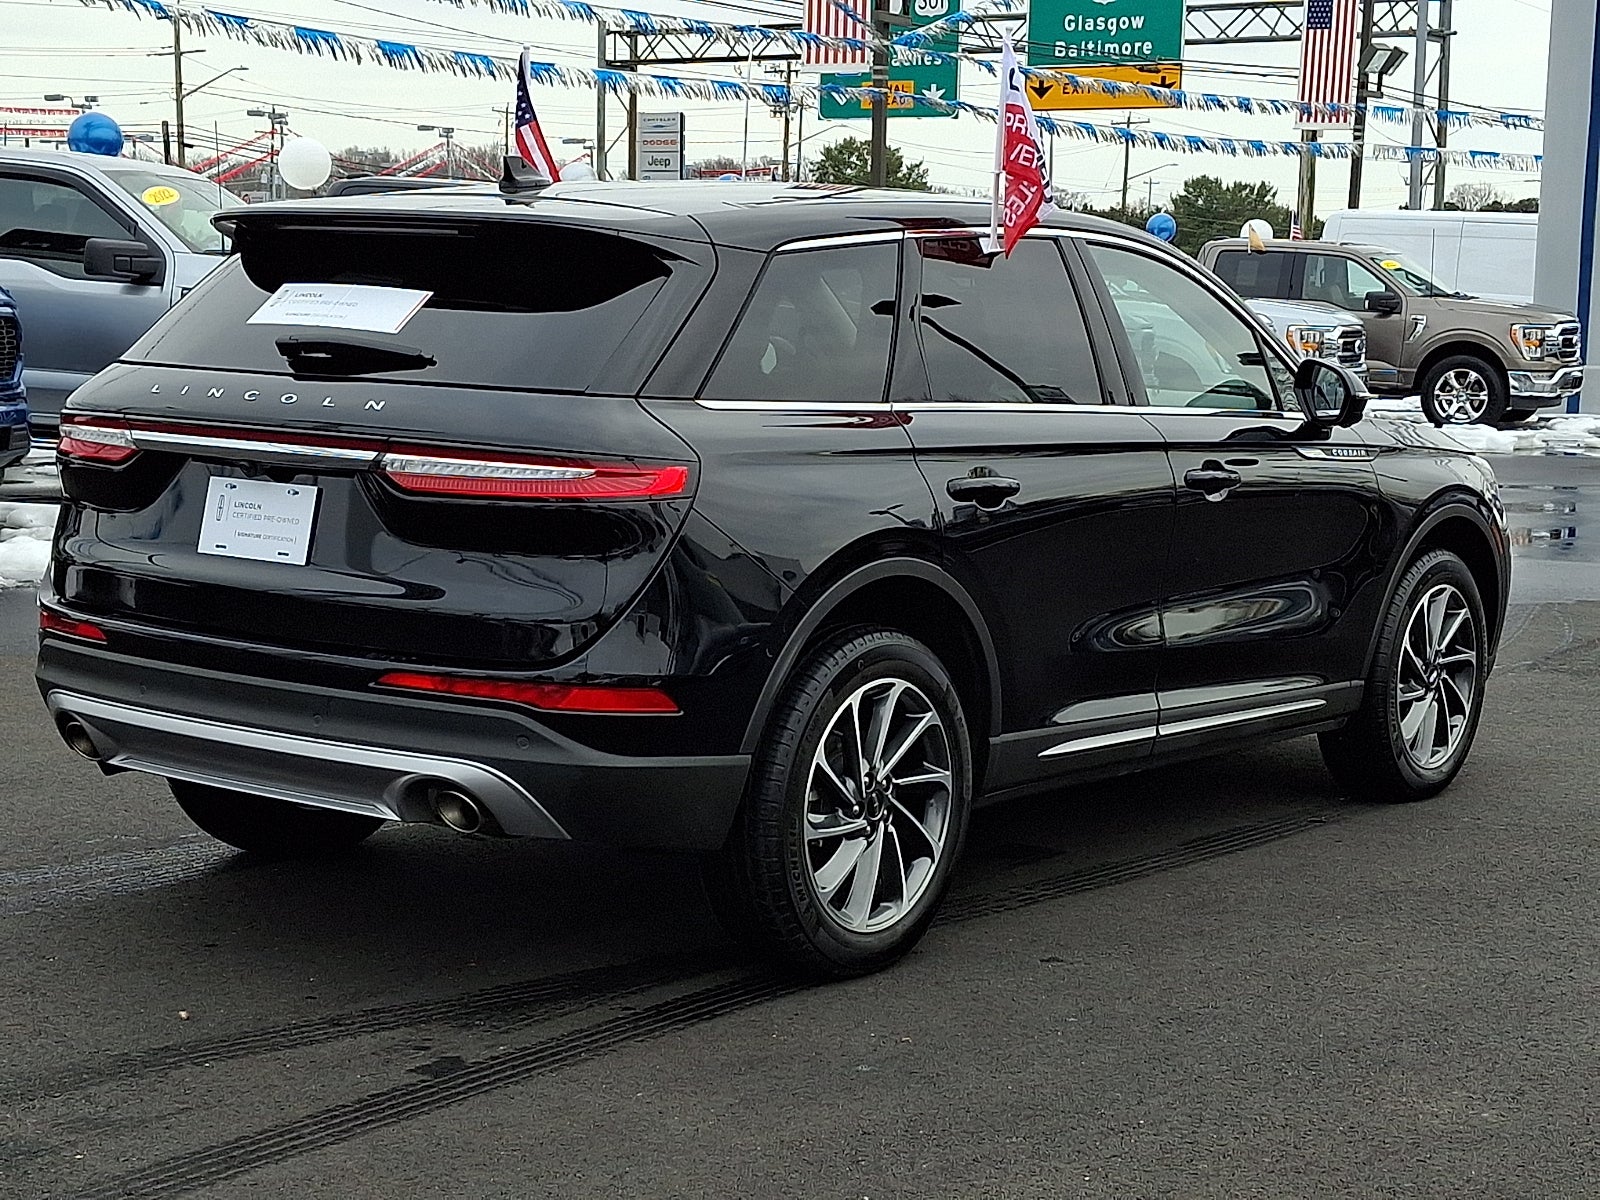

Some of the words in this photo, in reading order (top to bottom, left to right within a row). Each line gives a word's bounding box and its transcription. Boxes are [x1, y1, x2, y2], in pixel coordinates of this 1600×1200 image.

[1064, 14, 1145, 37] Glasgow
[1054, 39, 1153, 58] Baltimore
[647, 155, 671, 169] Jeep
[150, 384, 387, 412] LINCOLN
[234, 501, 262, 510] LINCOLN
